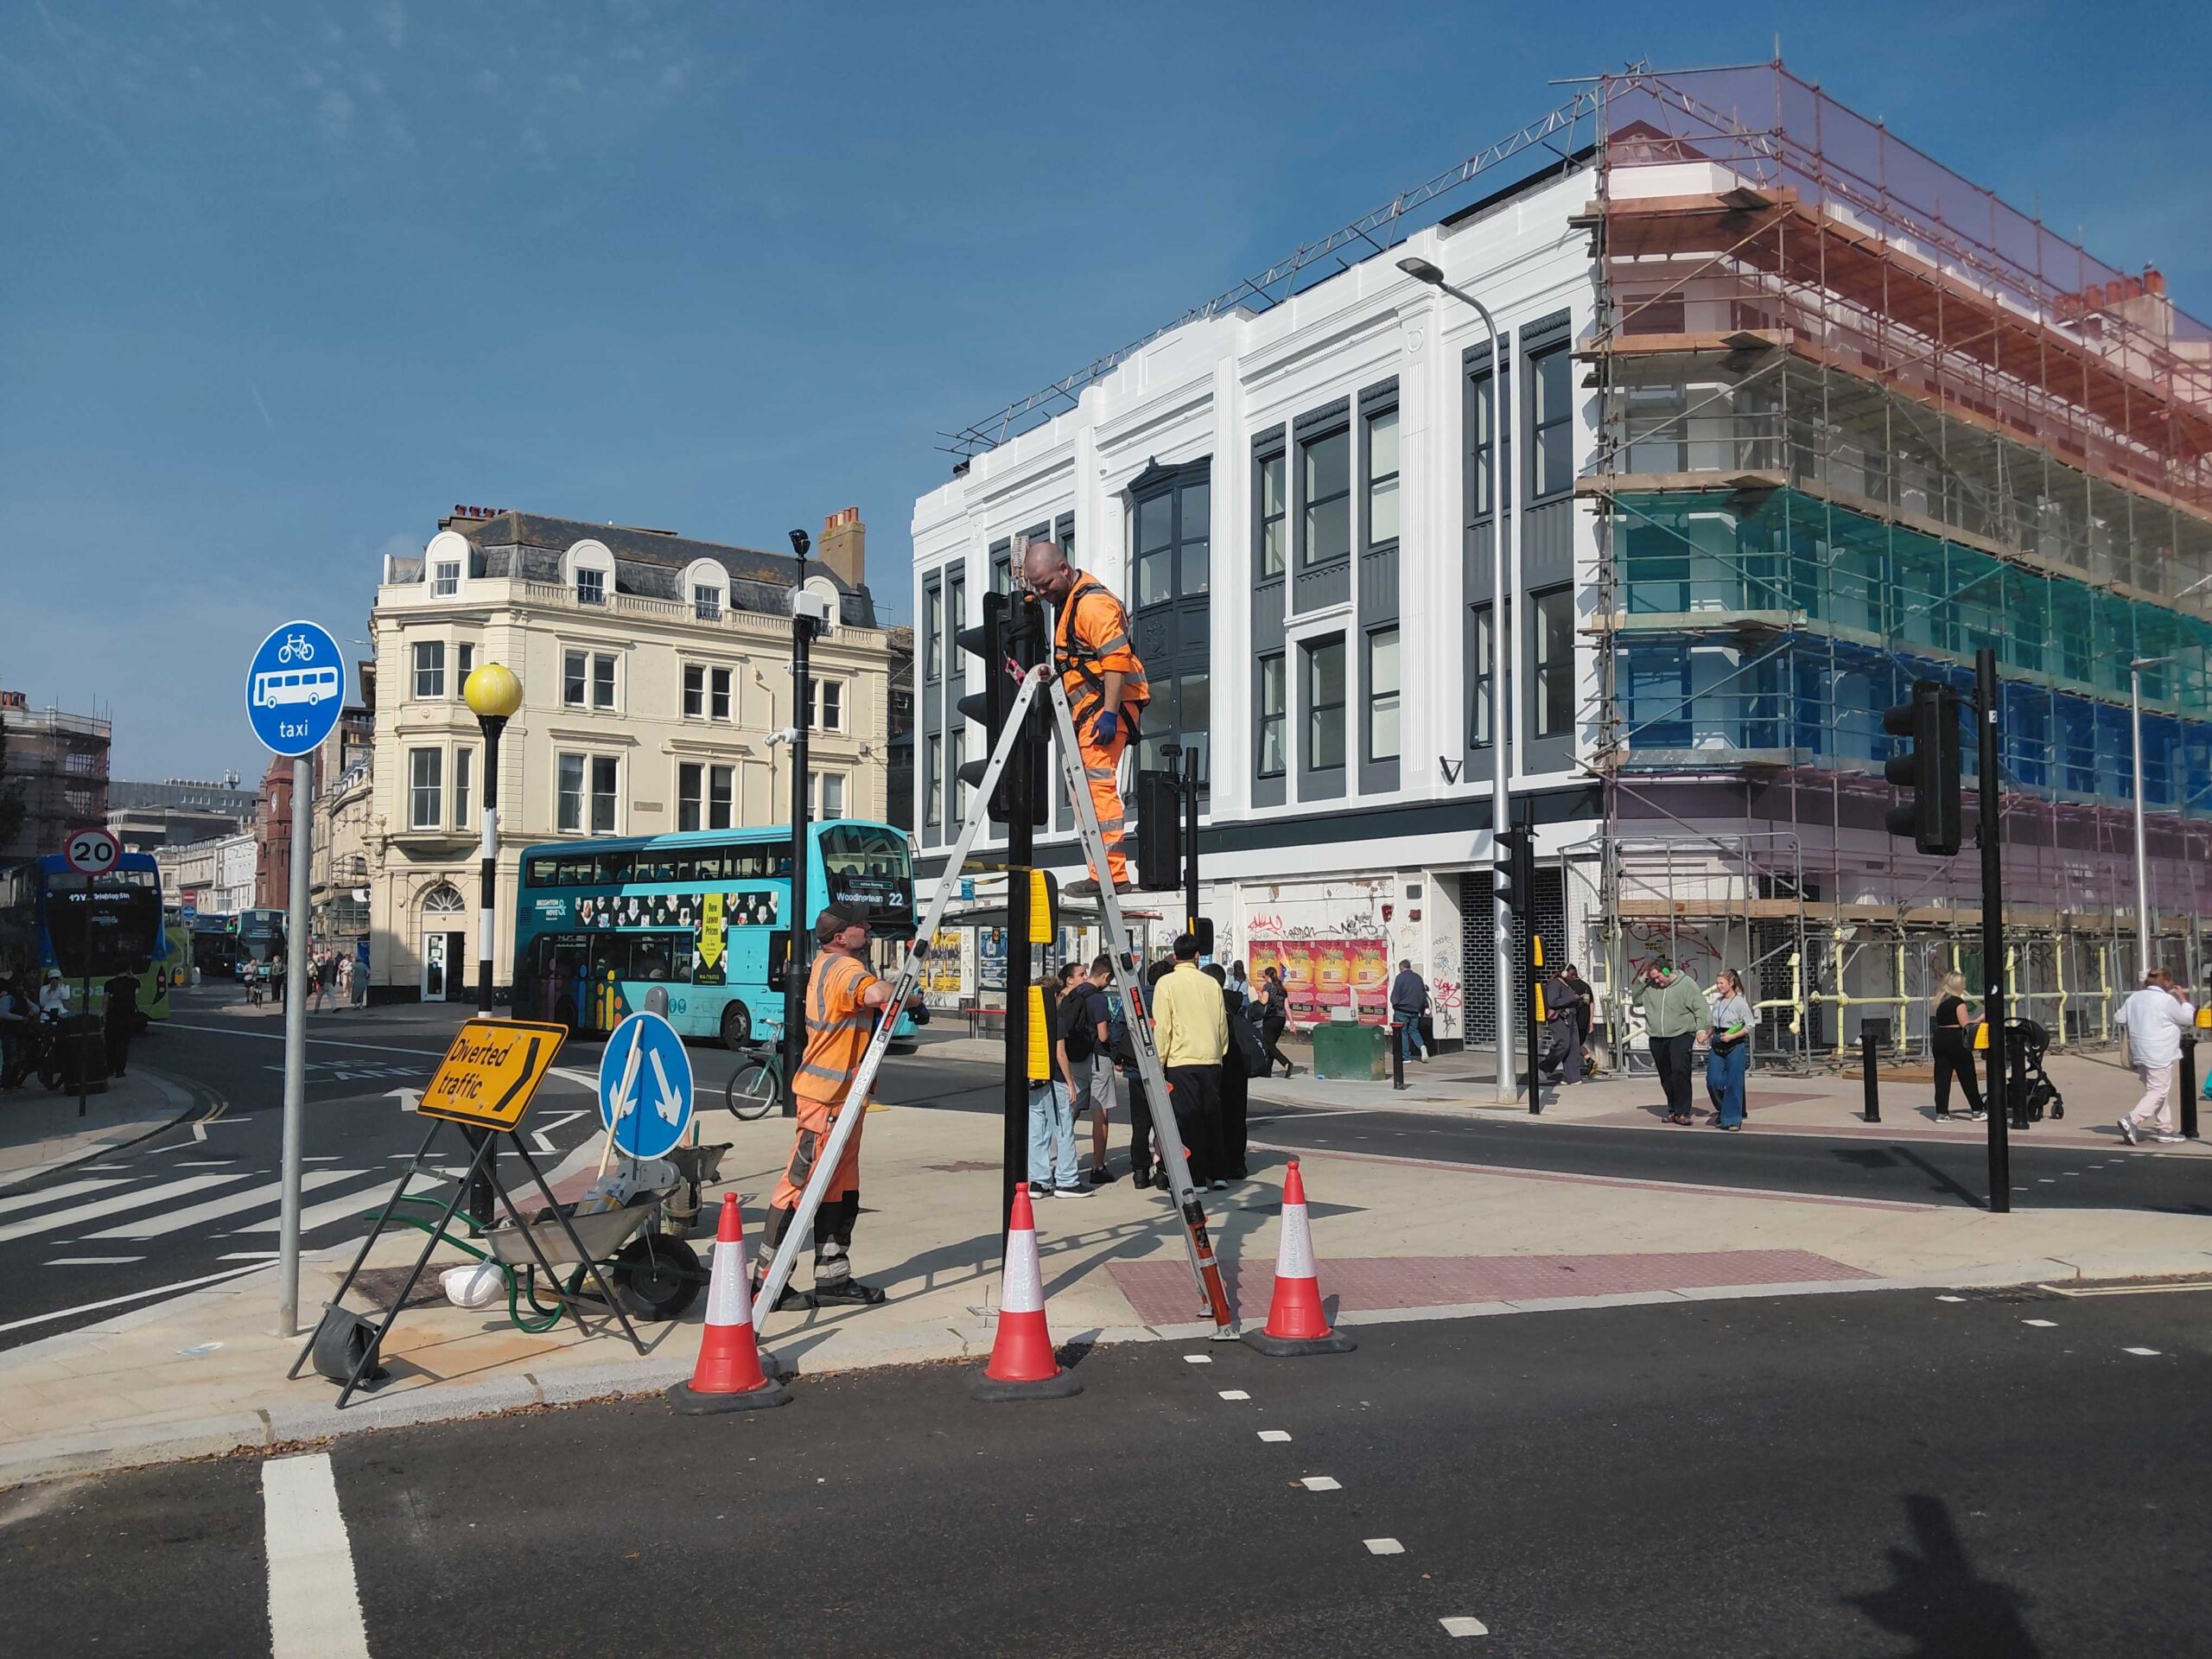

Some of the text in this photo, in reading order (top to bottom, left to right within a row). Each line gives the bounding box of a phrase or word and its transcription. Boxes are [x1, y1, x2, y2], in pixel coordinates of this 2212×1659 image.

[279, 719, 309, 739] taxi
[73, 842, 113, 862] 20
[888, 893, 903, 906] 22
[707, 916, 719, 925] Lower
[705, 926, 720, 936] Prices
[897, 976, 910, 1000] CONQUEST
[448, 1039, 513, 1067] Diverted
[436, 1071, 483, 1100] traffic
